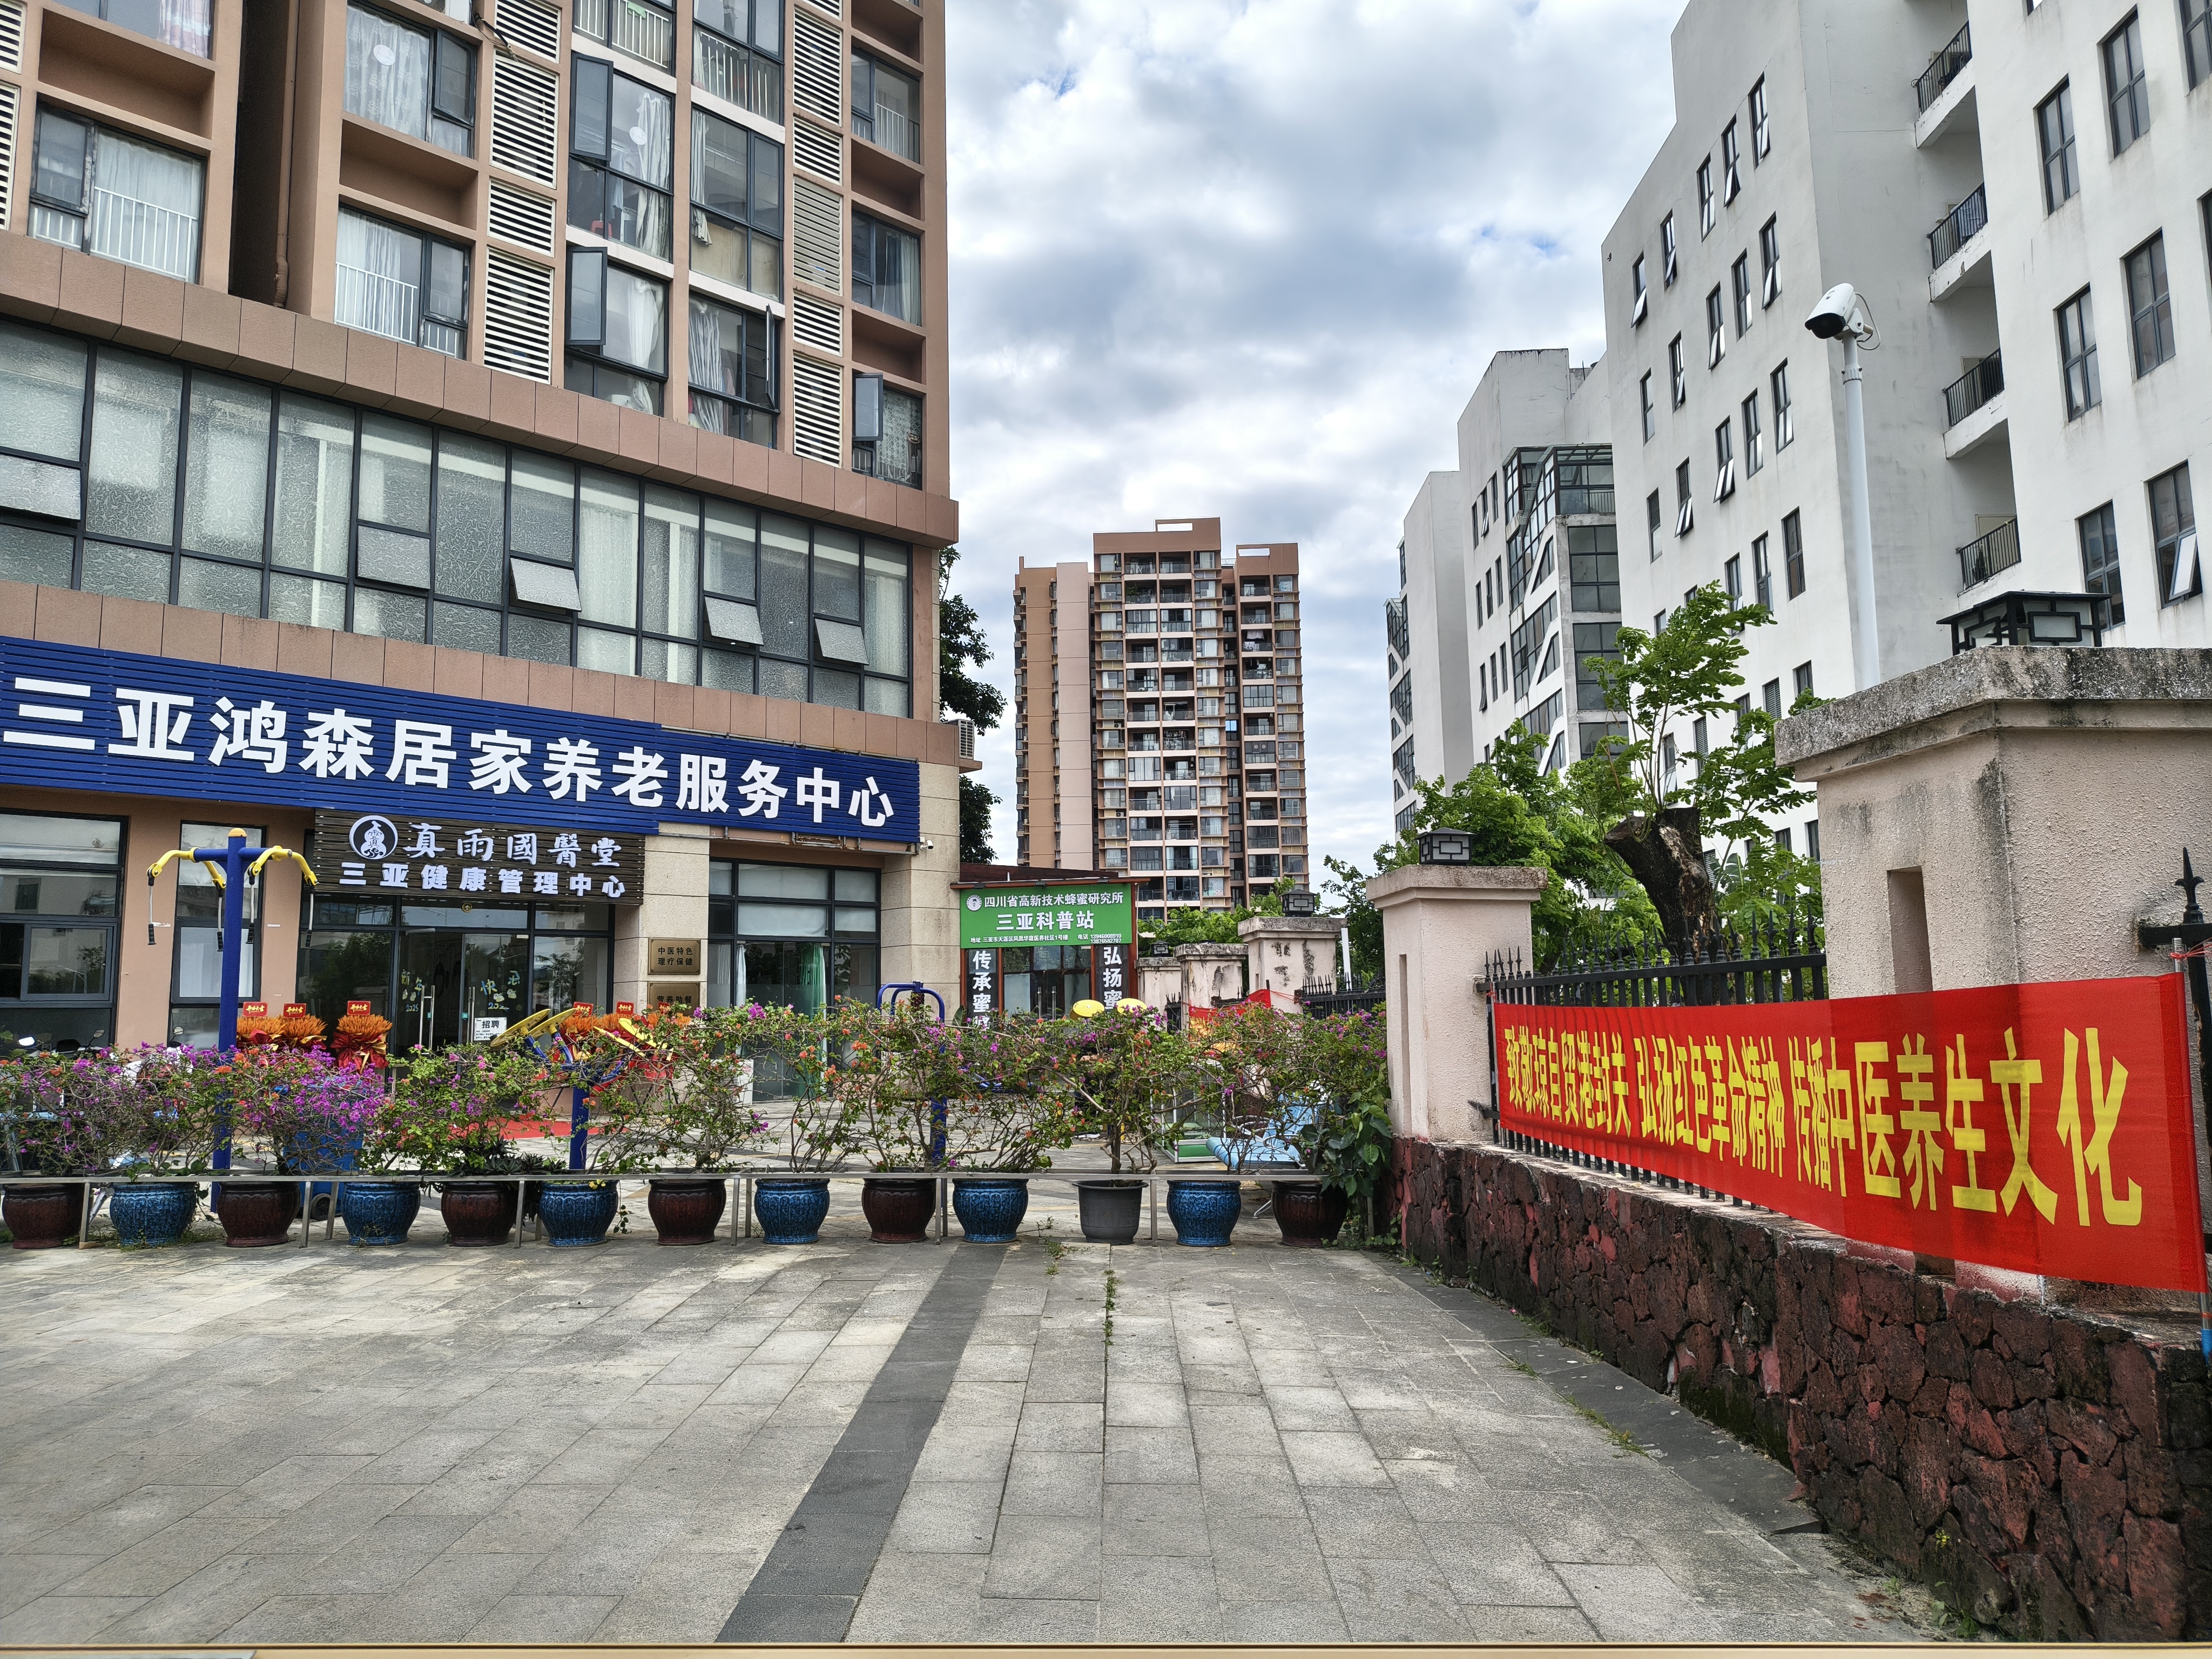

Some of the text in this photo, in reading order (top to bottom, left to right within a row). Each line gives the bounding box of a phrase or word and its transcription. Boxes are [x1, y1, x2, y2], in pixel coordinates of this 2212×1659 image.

[3, 677, 894, 827] 三亚鸿森居家养老服务中心
[403, 822, 622, 868] 真雨國醫堂
[340, 862, 625, 898] 三亚健康管理中心
[984, 892, 1123, 908] 四川省高新技术蜂蜜研究所
[996, 910, 1094, 930] 三亚科普站
[658, 947, 693, 955] 中医特色
[658, 957, 693, 966] 理疗保健
[657, 996, 692, 1004] 营养助餐
[482, 1020, 500, 1029] 招聘
[1505, 1024, 2142, 1226] 致敬琼自贸港封关 弘扬红色革命精神 传播中医养生文化
